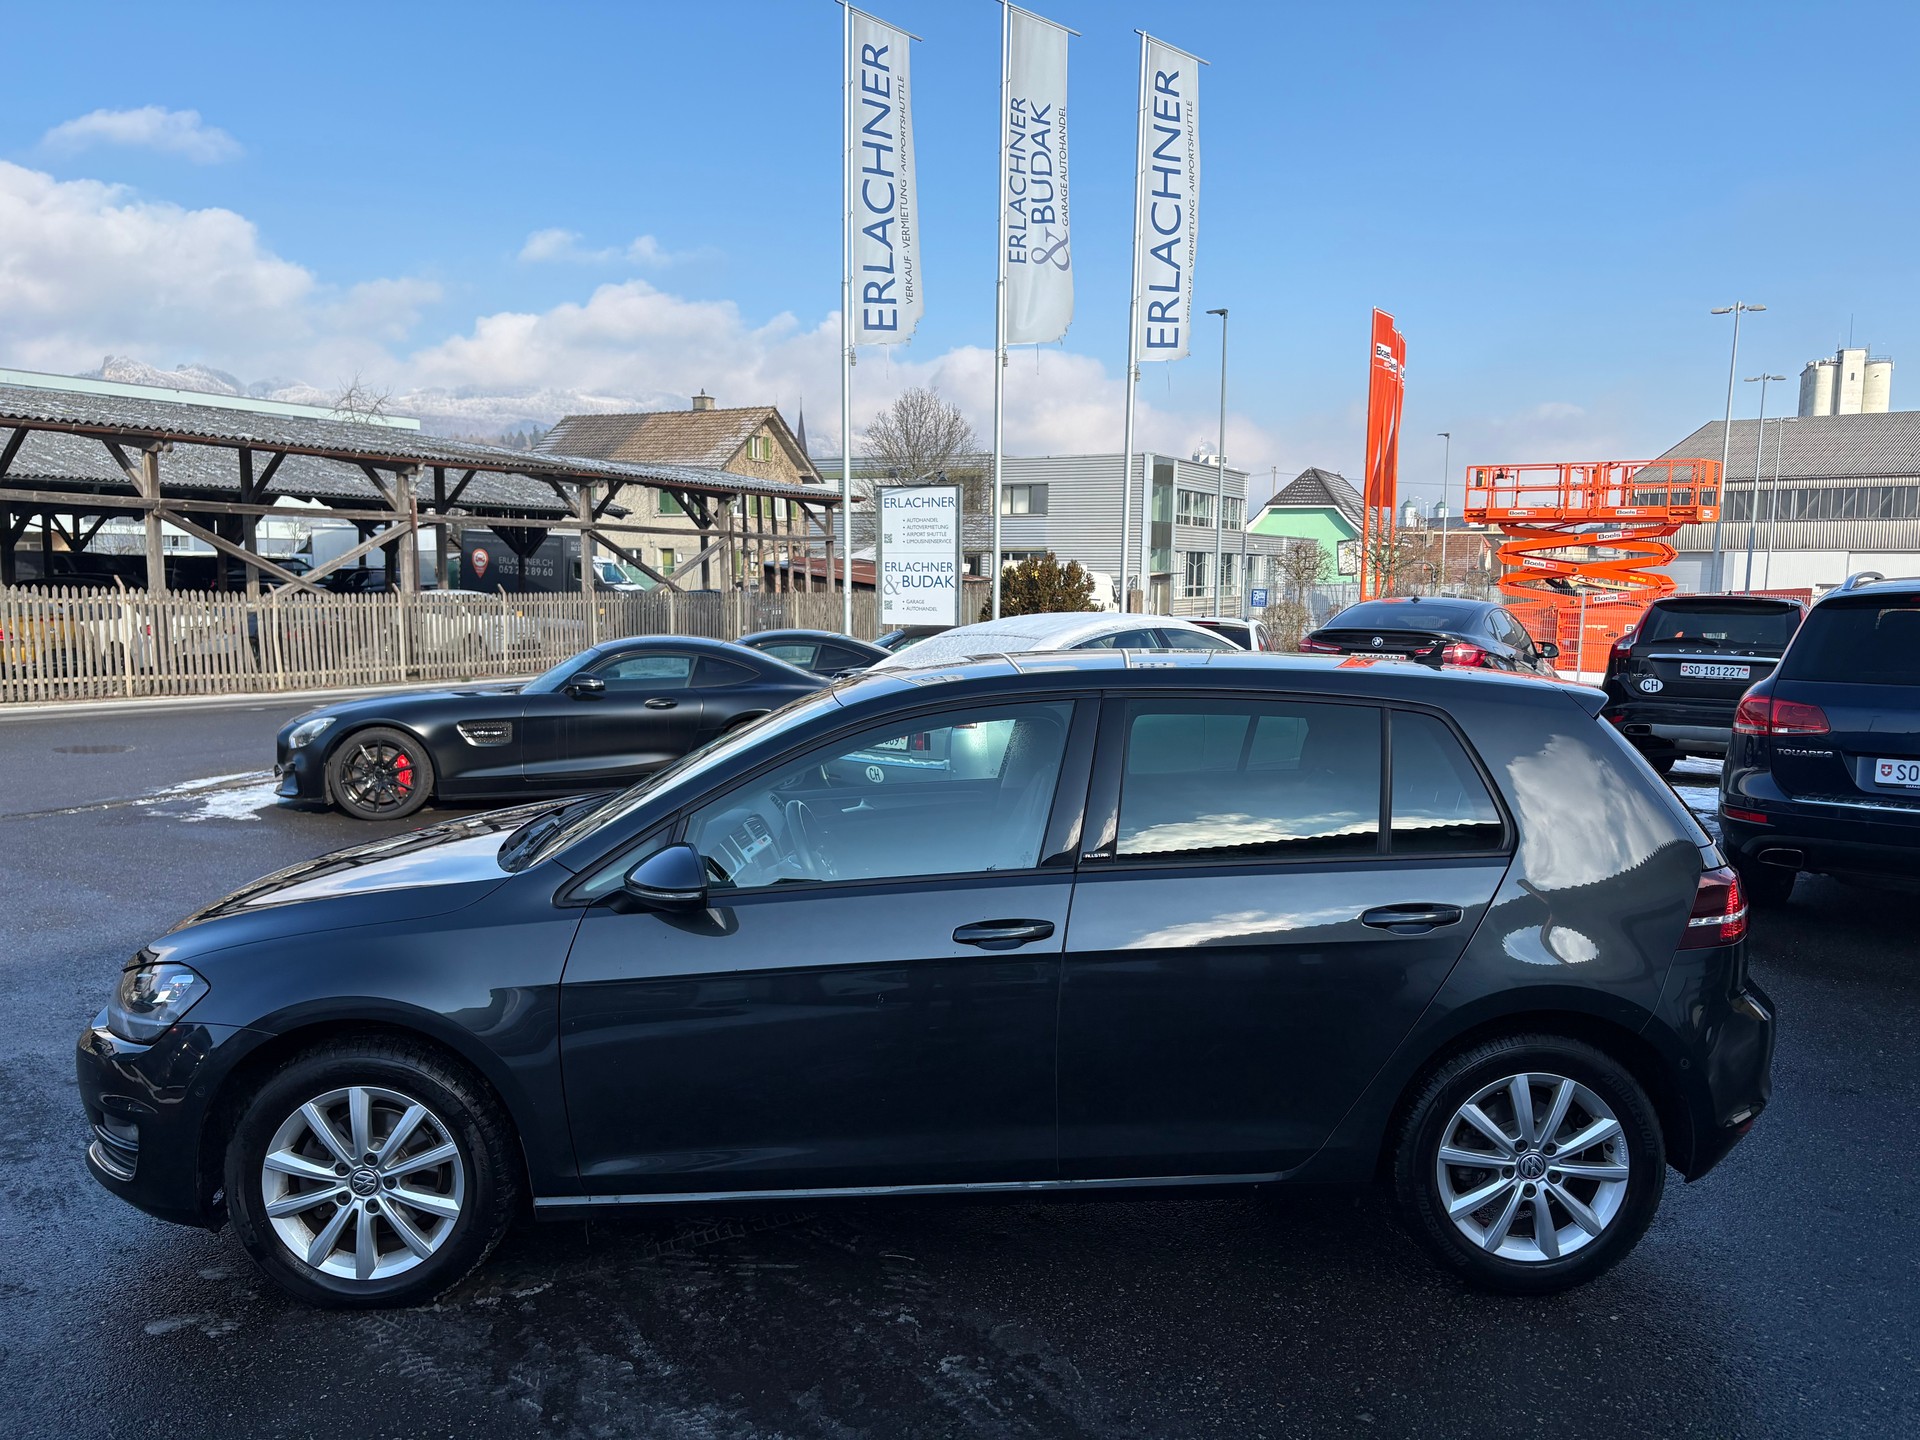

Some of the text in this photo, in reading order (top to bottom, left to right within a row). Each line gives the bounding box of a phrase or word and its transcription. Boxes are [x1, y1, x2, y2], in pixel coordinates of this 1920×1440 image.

[1185, 100, 1196, 192] AIRPORTSHUTTLE
[1059, 107, 1069, 227] GARAGE AUTOHANDEL
[861, 43, 898, 331] ERLACHNER
[896, 75, 914, 304] VERKAUF VERMIETUNG AIRPORTSHUTTLE
[1008, 96, 1027, 265] ERLACHNER
[1030, 102, 1070, 272] & BUDAK
[1146, 69, 1182, 349] ERLACHNER
[1187, 199, 1196, 268] VERMIETUNG
[883, 497, 956, 508] ERLACHNER
[1598, 532, 1621, 540] Boels
[498, 556, 554, 567] ERLACNER.CH
[884, 561, 954, 572] ERLACHNER
[1524, 559, 1545, 568] Boels
[531, 566, 542, 576] 89
[543, 567, 554, 577] 60
[883, 574, 955, 595] & BUDAK
[1643, 680, 1659, 691] CH
[1776, 748, 1834, 758] TOUAREG
[868, 767, 881, 781] CH
[1896, 764, 1920, 782] SO
